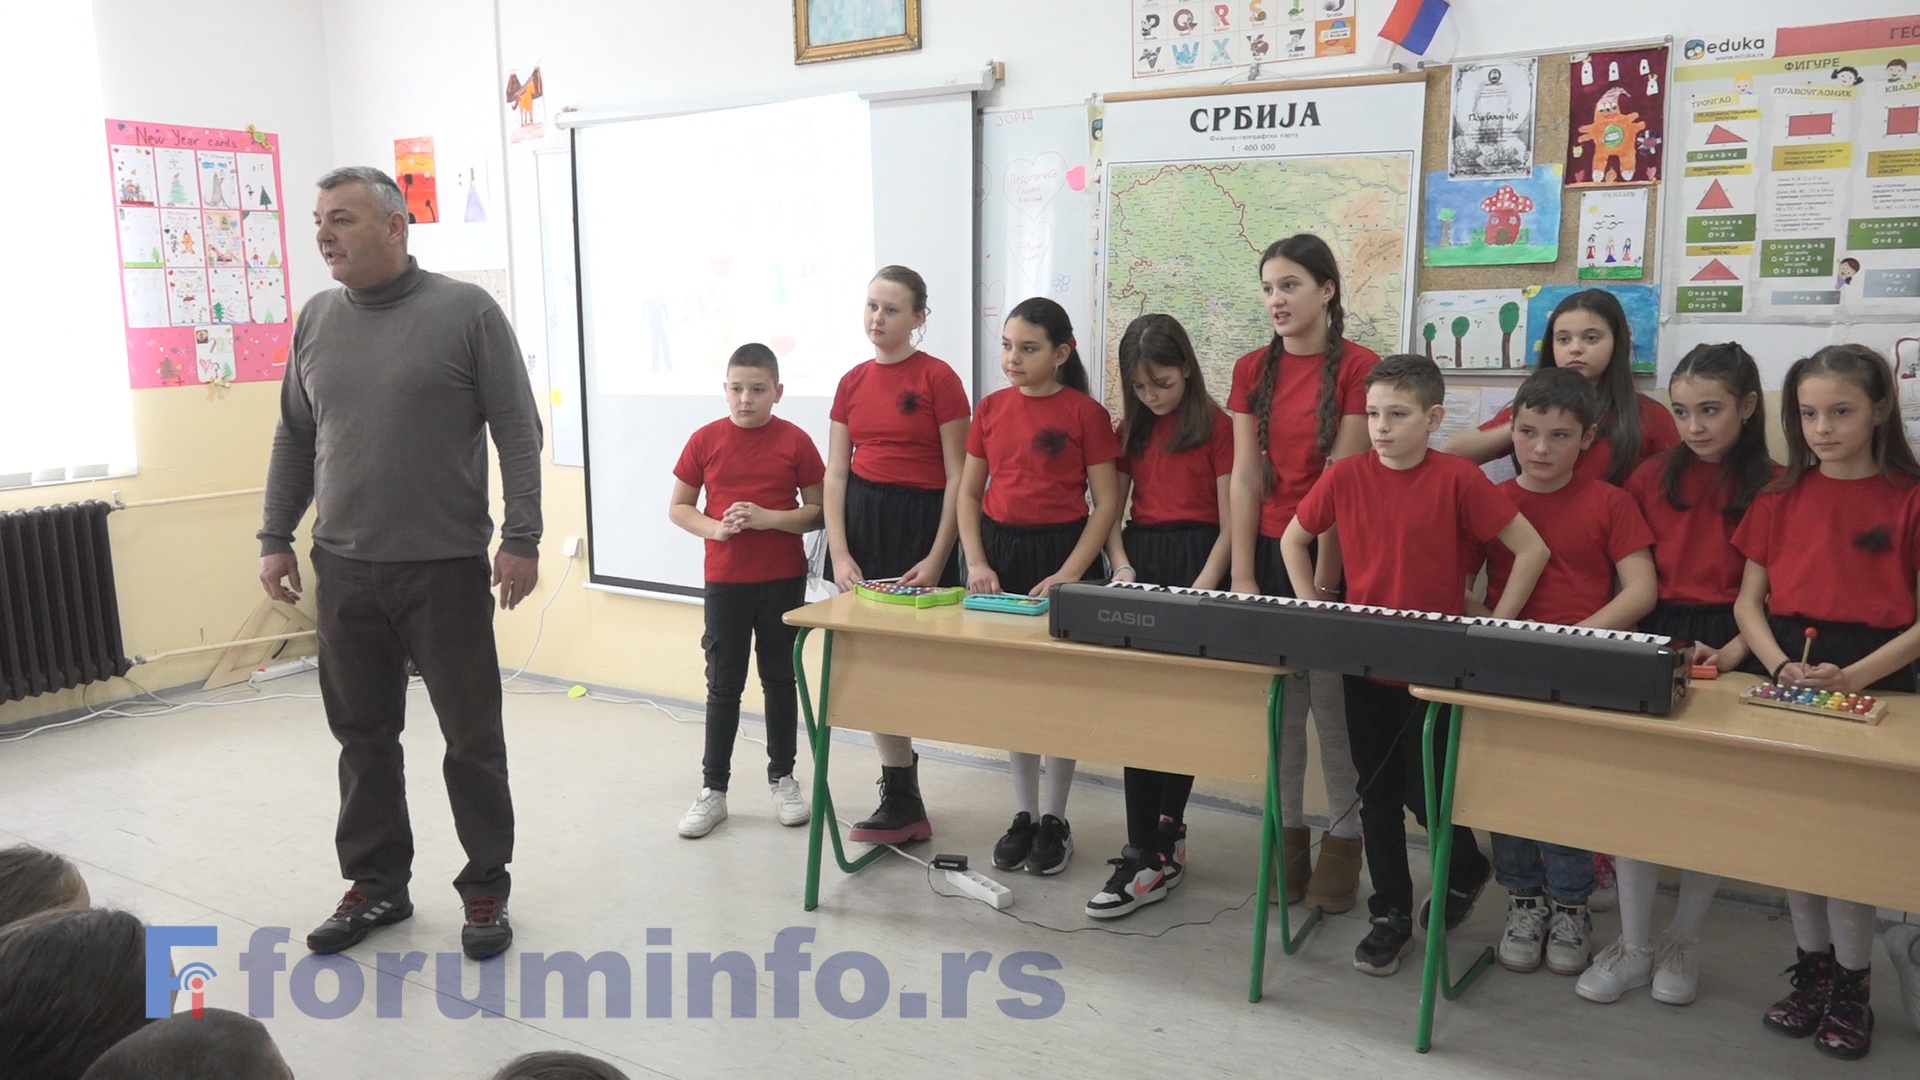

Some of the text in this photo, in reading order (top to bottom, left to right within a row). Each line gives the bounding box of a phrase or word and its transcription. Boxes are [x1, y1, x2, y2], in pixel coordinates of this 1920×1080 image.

[1707, 37, 1765, 54] eduka
[1784, 58, 1840, 71] ФИГУРЕ
[1774, 87, 1852, 97] ПРАВОУГАОНИК
[1692, 96, 1732, 108] ТРОУГАО
[1190, 101, 1321, 133] СРБИЈА
[135, 126, 238, 148] New Year cards
[1098, 610, 1156, 627] CASIO
